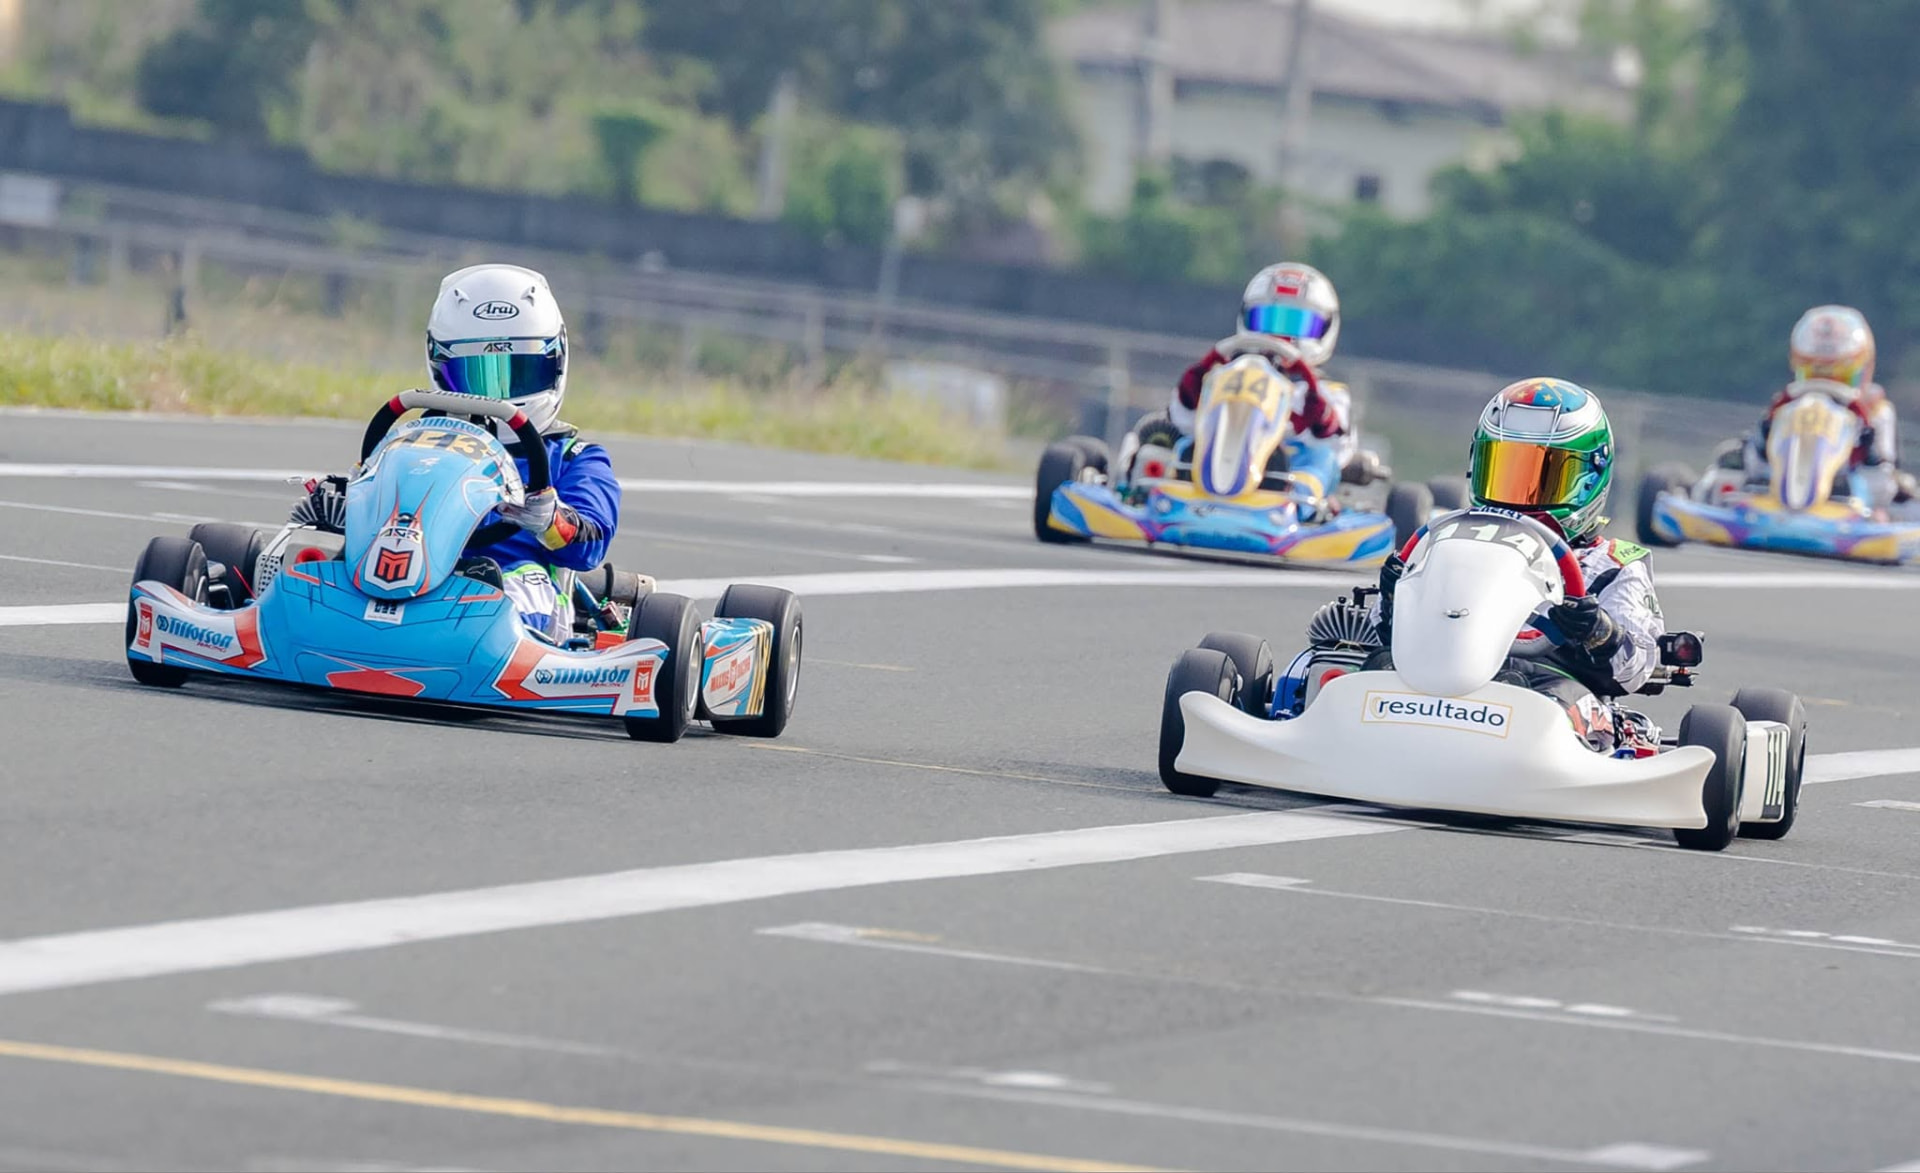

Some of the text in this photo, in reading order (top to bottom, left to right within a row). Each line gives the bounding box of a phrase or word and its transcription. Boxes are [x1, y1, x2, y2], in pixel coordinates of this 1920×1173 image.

[475, 302, 515, 316] Arai
[1222, 369, 1270, 402] 44
[1434, 522, 1541, 562] 114
[168, 616, 234, 649] Tillotson
[552, 667, 631, 685] Tillotson
[1378, 699, 1505, 727] resultado
